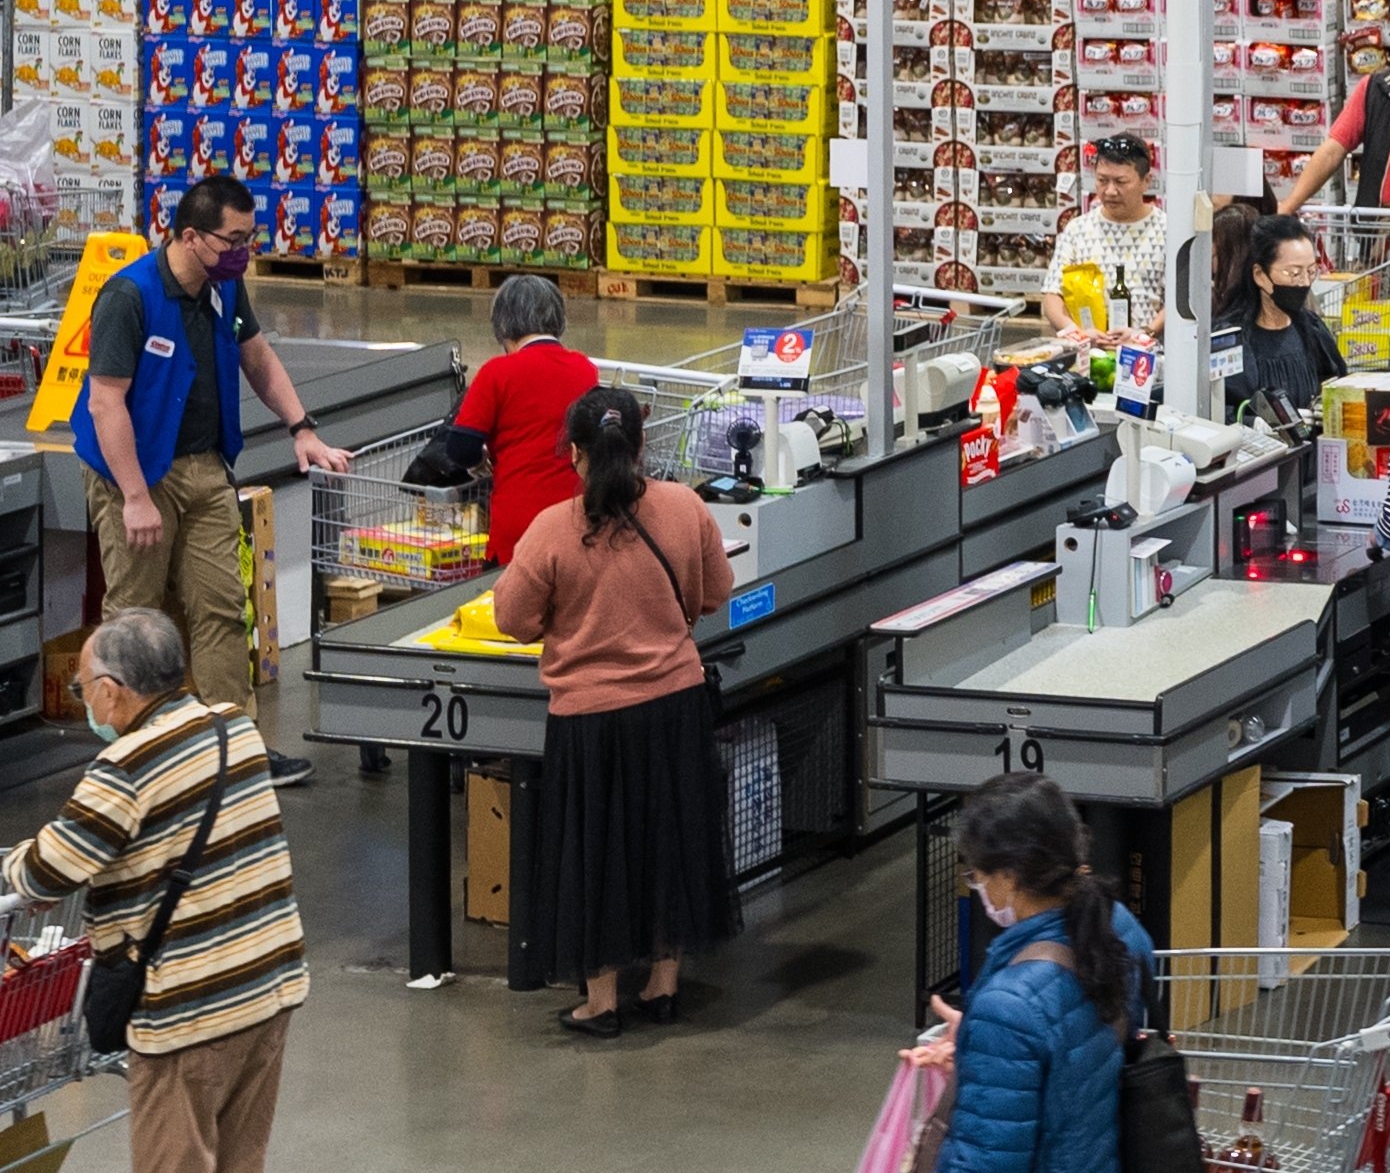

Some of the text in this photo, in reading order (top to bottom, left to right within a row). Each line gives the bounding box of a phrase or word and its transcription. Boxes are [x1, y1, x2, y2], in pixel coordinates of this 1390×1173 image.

[17, 33, 40, 45] CORN
[58, 35, 81, 47] CORN
[98, 38, 122, 49] CORN
[18, 45, 41, 55] FLAKES
[58, 48, 81, 58] FLAKES
[99, 50, 122, 60] FLAKES
[57, 107, 80, 118] CORN
[98, 109, 122, 120] CORN
[57, 119, 81, 129] FLAKES
[98, 121, 122, 130] FLAKES
[421, 693, 468, 741] 20
[995, 738, 1044, 774] 19
